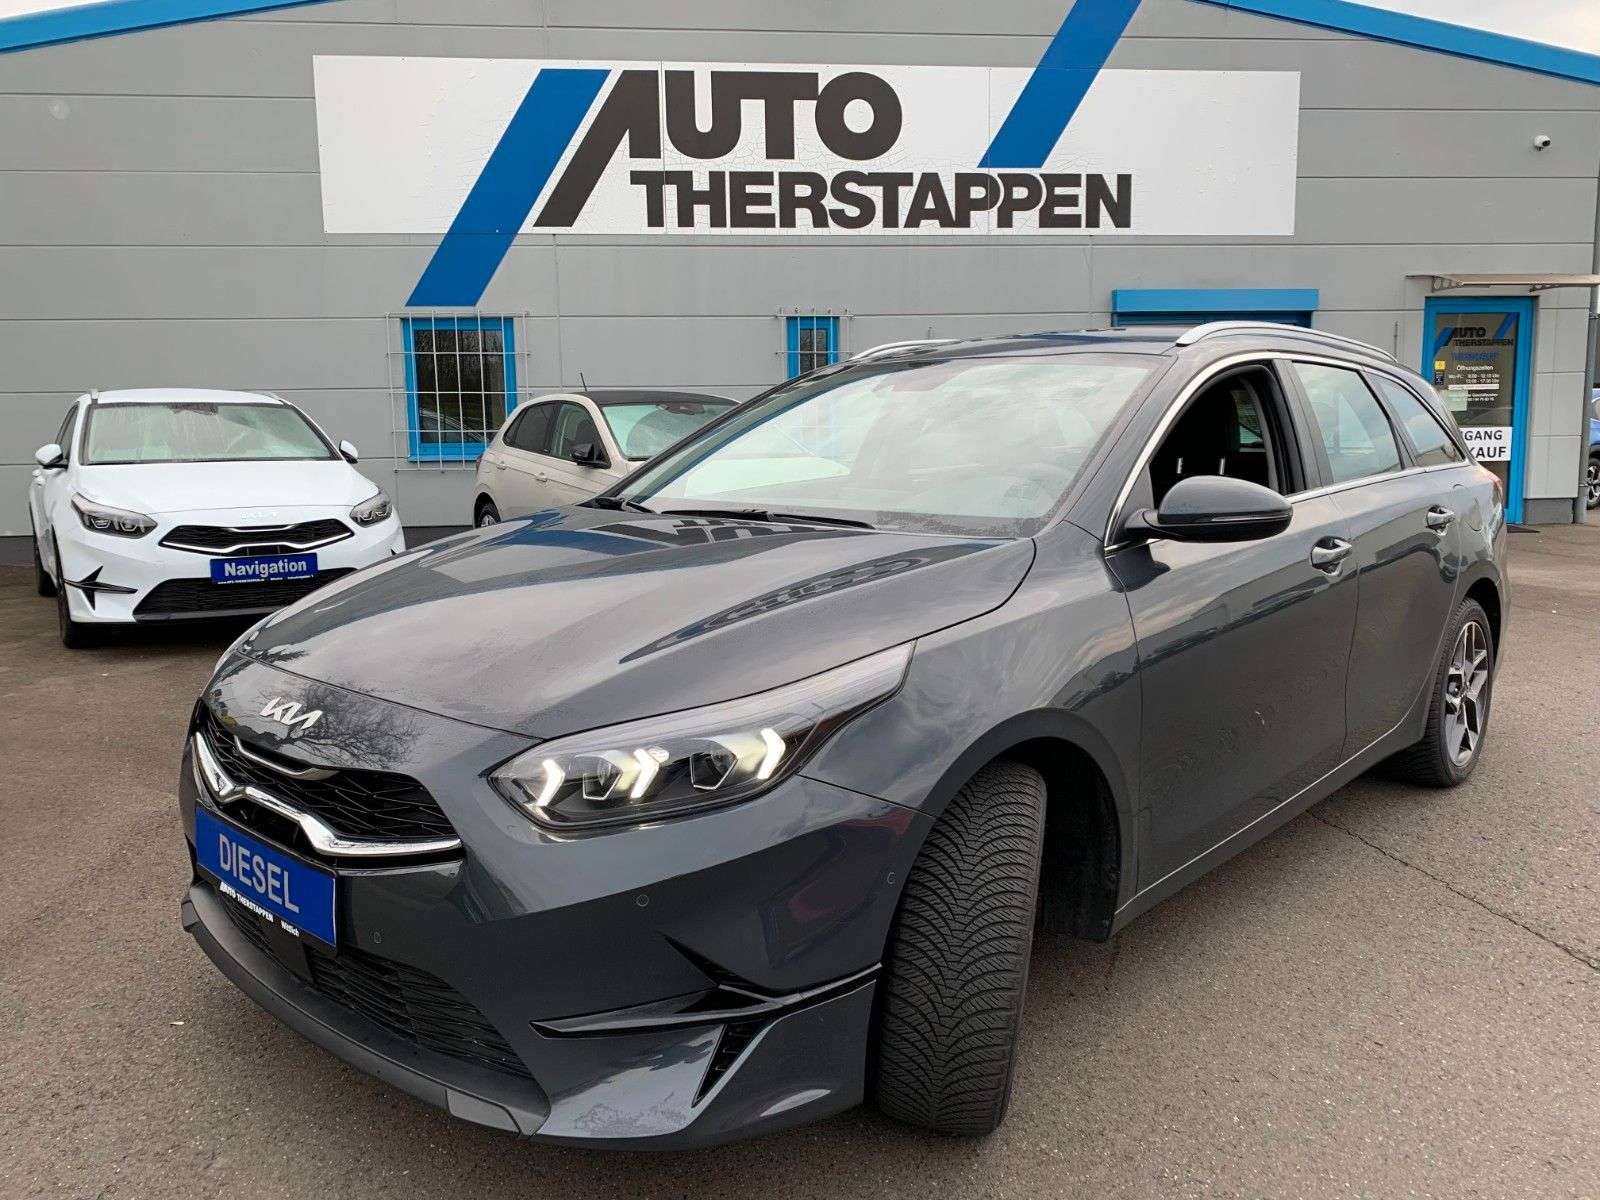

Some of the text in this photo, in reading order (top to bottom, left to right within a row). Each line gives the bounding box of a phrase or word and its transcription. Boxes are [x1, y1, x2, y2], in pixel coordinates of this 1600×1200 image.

[532, 69, 903, 228] AUTO
[629, 170, 1132, 230] THERSTAPPEN
[1443, 326, 1487, 347] AUTO
[1460, 430, 1503, 441] GANG
[224, 559, 307, 578] Navigation
[259, 696, 323, 730] KIA
[219, 833, 300, 914] DIESEL
